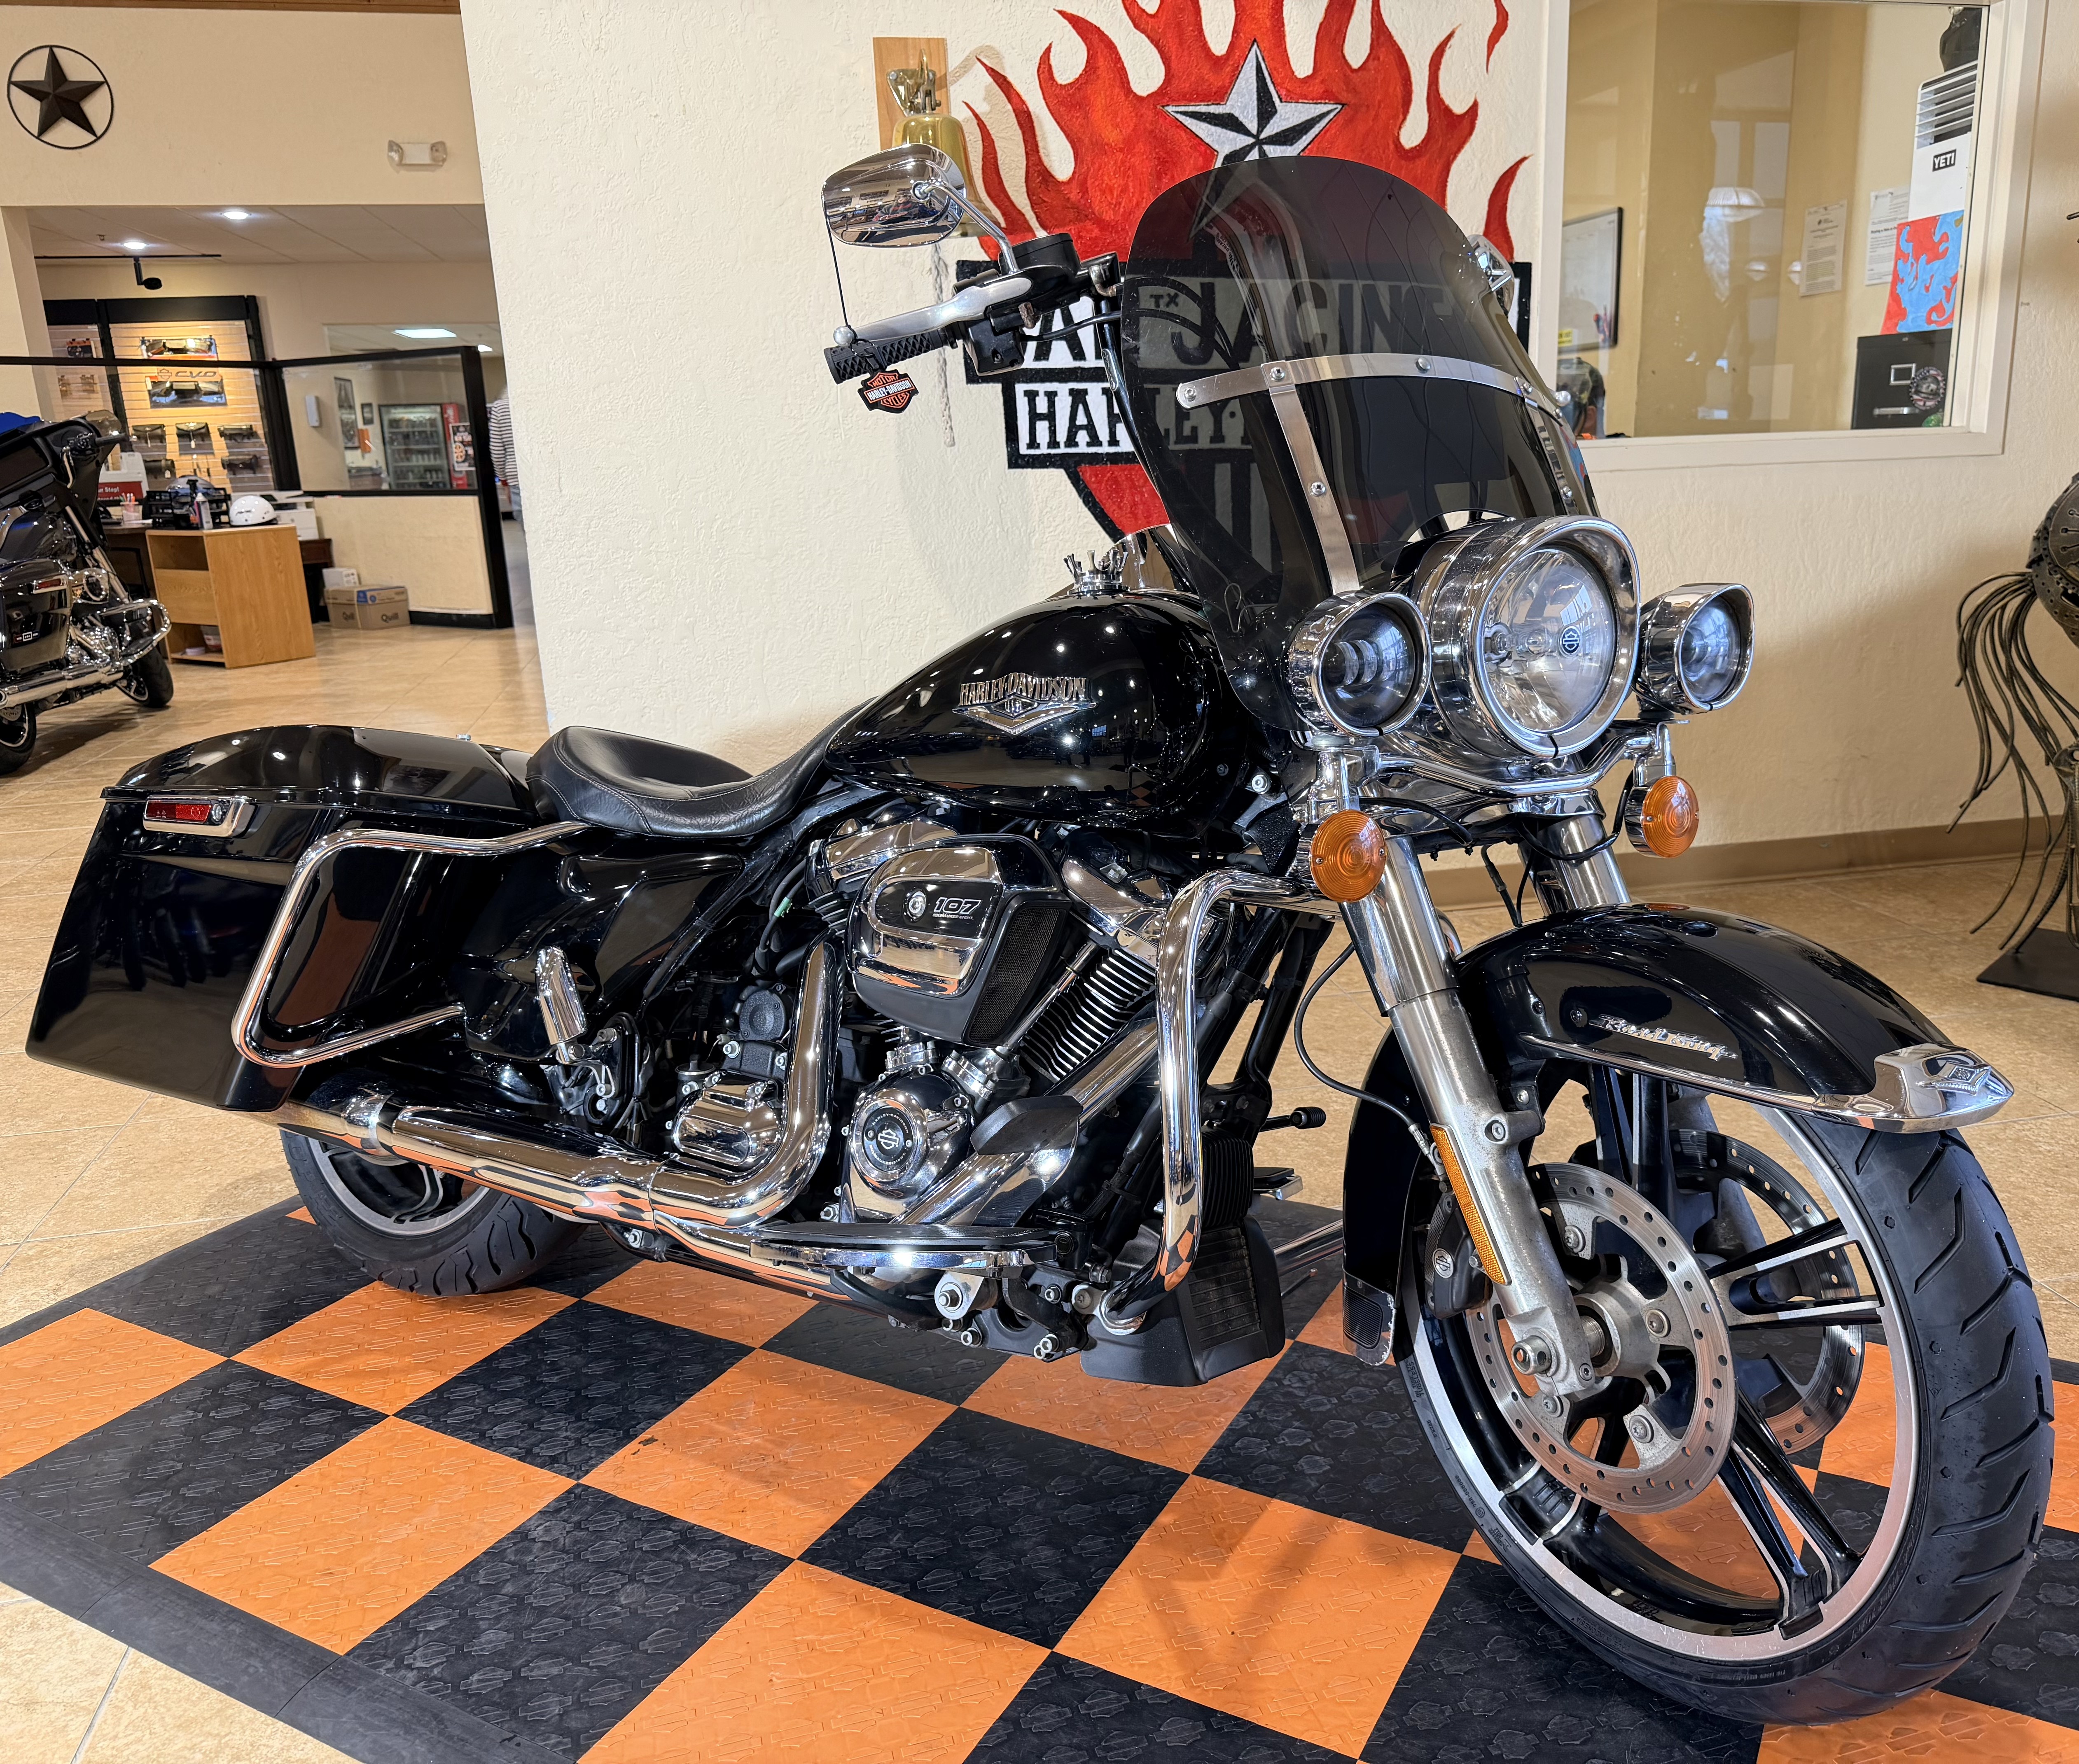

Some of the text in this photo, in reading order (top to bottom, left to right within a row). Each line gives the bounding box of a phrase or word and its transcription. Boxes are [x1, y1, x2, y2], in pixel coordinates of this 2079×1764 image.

[1934, 152, 1955, 169] YETI
[1150, 292, 1180, 308] TX
[872, 375, 896, 387] MOTOR
[867, 380, 912, 401] HARLEY-DAVIDSON
[883, 393, 906, 406] CYCLES
[933, 897, 982, 915] 107
[872, 1113, 909, 1134] HARLEY-DAVIDSON
[1409, 1361, 1425, 1397] TUBELESS
[1576, 1617, 1605, 1639] INDONESIA
